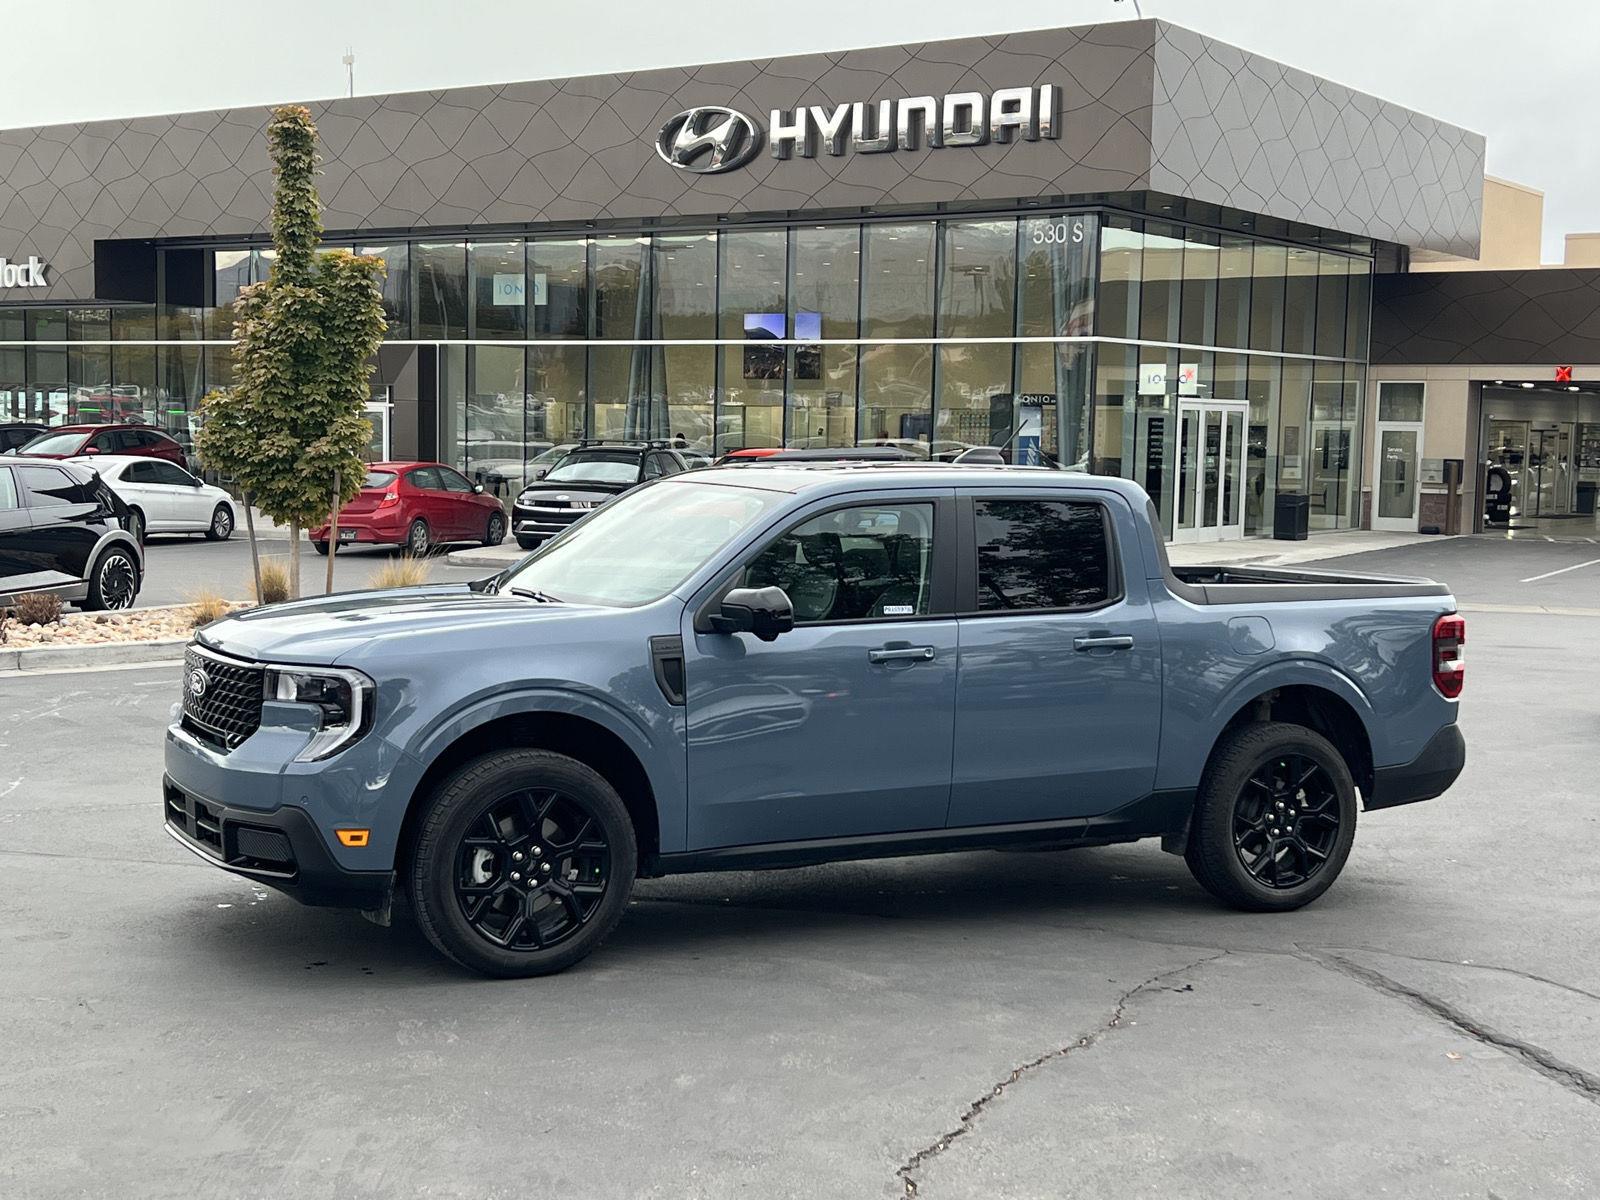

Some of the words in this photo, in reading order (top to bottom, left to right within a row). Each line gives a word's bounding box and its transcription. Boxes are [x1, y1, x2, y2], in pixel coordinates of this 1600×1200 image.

[769, 84, 1062, 160] HYUNDAI
[1032, 223, 1067, 244] 530
[1072, 222, 1083, 243] S
